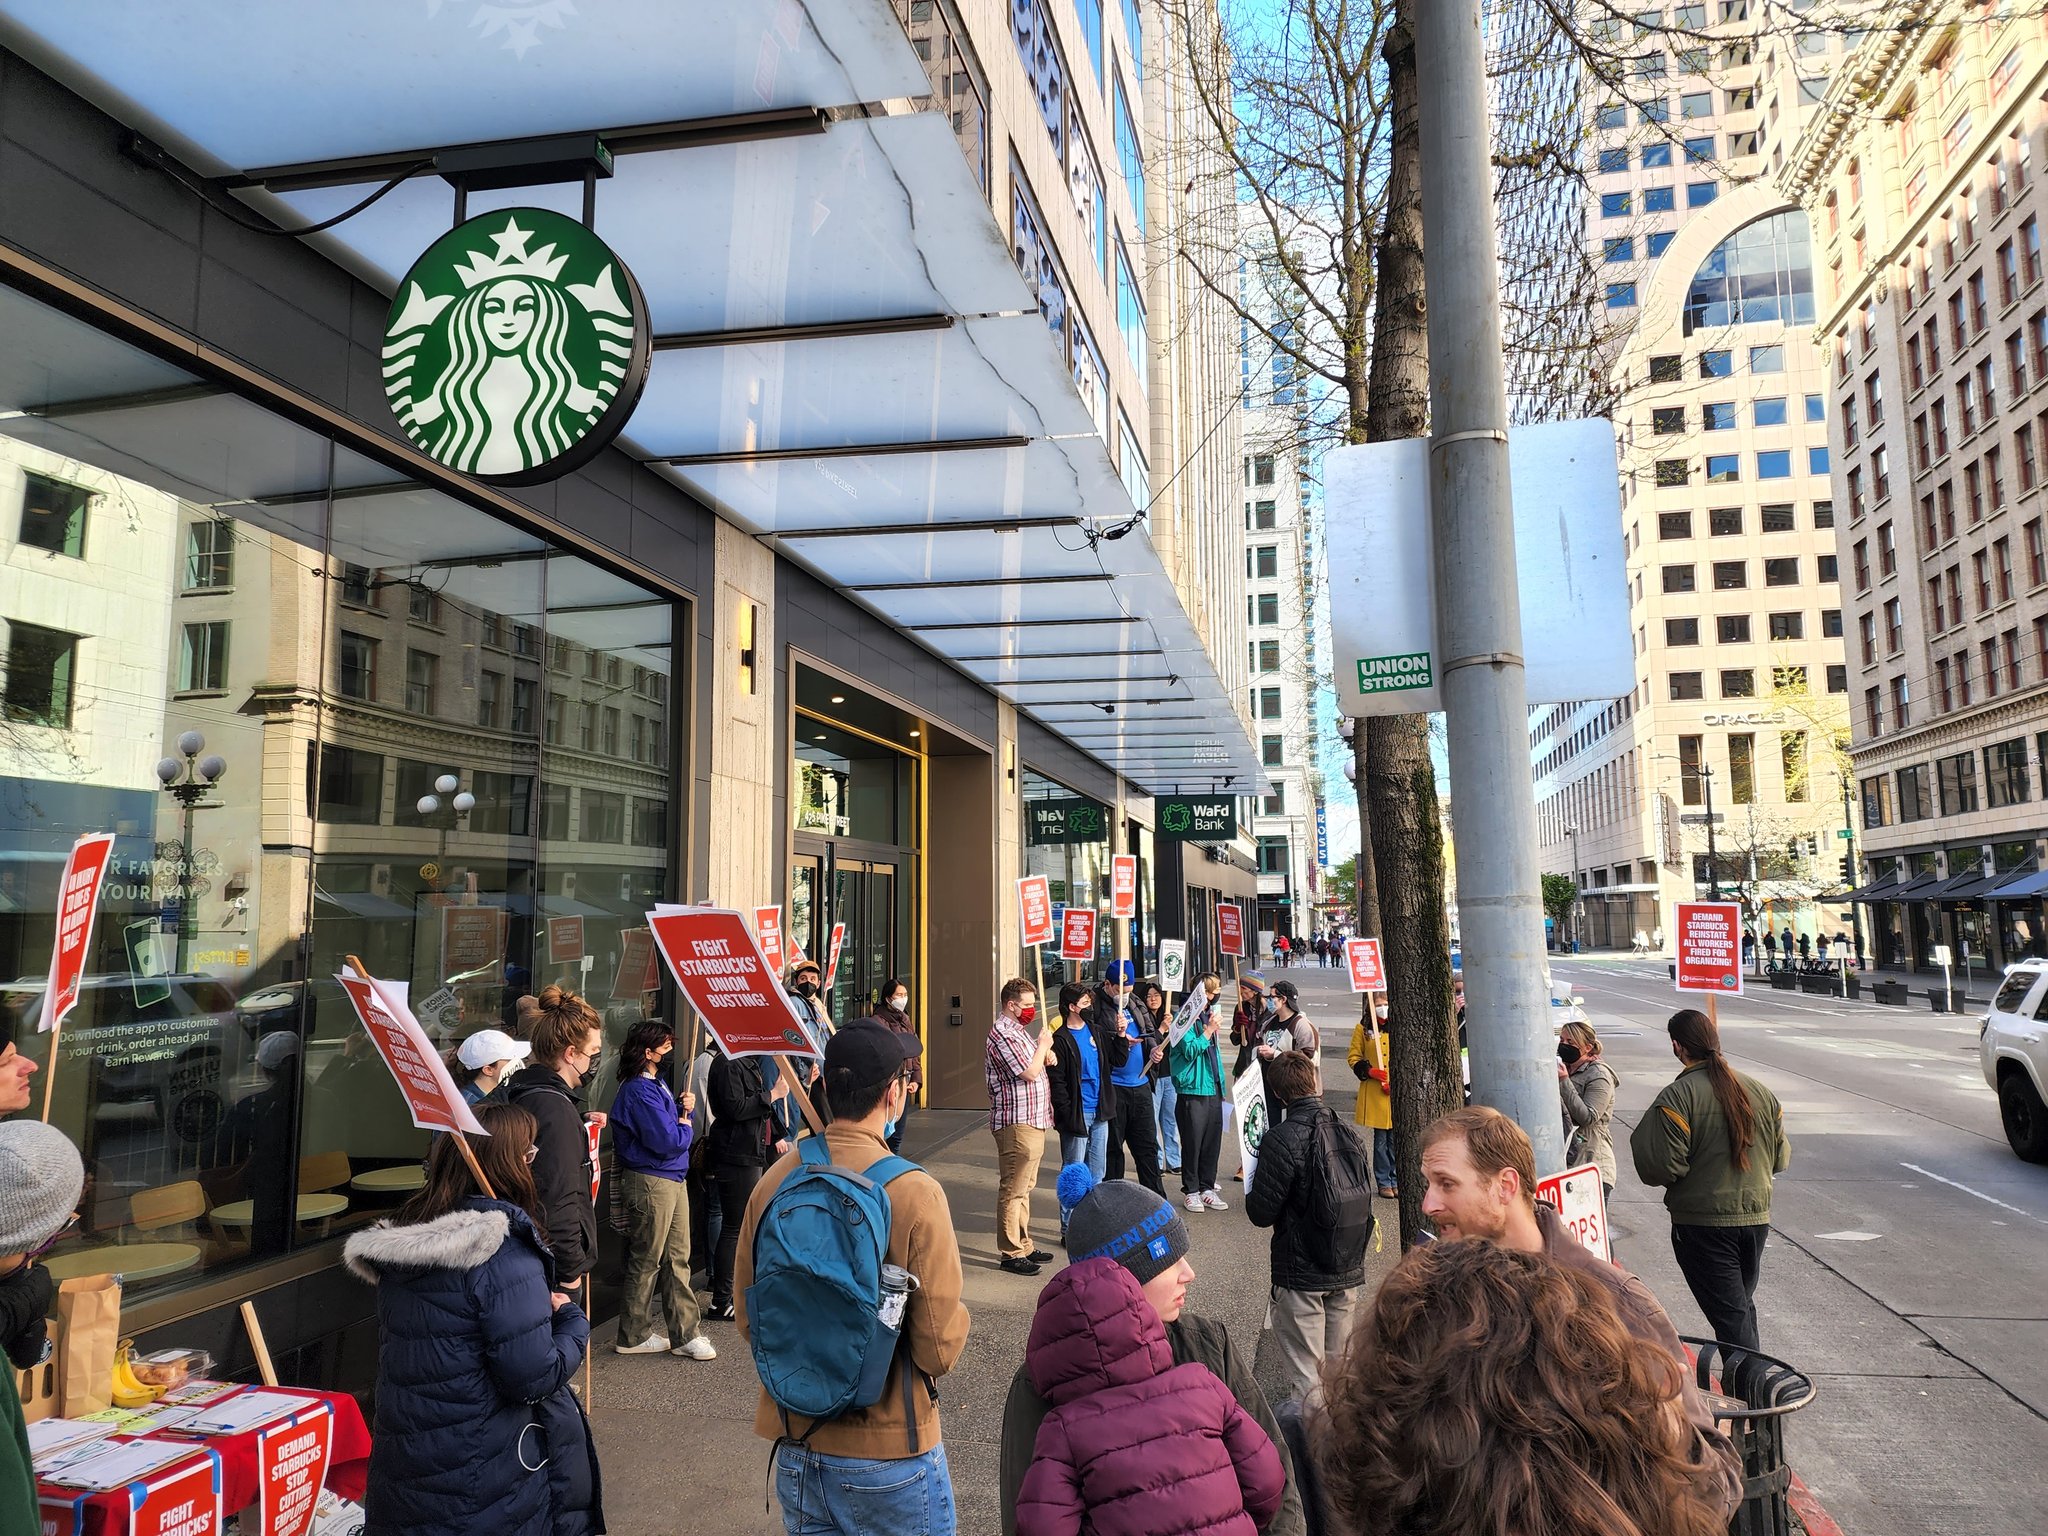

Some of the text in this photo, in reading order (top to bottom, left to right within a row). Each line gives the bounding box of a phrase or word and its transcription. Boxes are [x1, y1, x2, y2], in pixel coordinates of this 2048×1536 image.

[1360, 654, 1428, 676] UNION
[1362, 672, 1430, 691] STRONG
[1703, 711, 1785, 727] ORACLE
[1193, 804, 1229, 818] WaFd
[1195, 818, 1225, 831] Bank
[1317, 814, 1327, 860] ROSS
[100, 886, 150, 901] YOUR
[1686, 921, 1729, 931] STARBUCKS
[1692, 912, 1724, 922] DEMAND
[1683, 938, 1734, 949] ALL WORKERS
[1689, 930, 1728, 940] REINSTATE
[691, 939, 731, 957] FIGHT
[1690, 948, 1727, 957] FIRED FOR
[679, 956, 757, 976] STARBUCKS'
[1685, 956, 1733, 967] ORGANIZING!
[706, 976, 751, 992] UNION
[706, 993, 769, 1009] BUSTING!
[59, 1016, 220, 1044] Download the app to customize
[68, 1030, 210, 1061] your drink, order ahead and
[387, 1031, 408, 1048] STOP
[105, 1049, 178, 1068] earn Rewards.
[277, 1431, 316, 1462] DEMAND
[271, 1444, 322, 1482] STARBUCKS
[286, 1468, 309, 1492] STOP
[279, 1480, 313, 1512] CUTTING
[159, 1499, 195, 1532] FIGHT
[274, 1494, 313, 1532] EMPLOYEE
